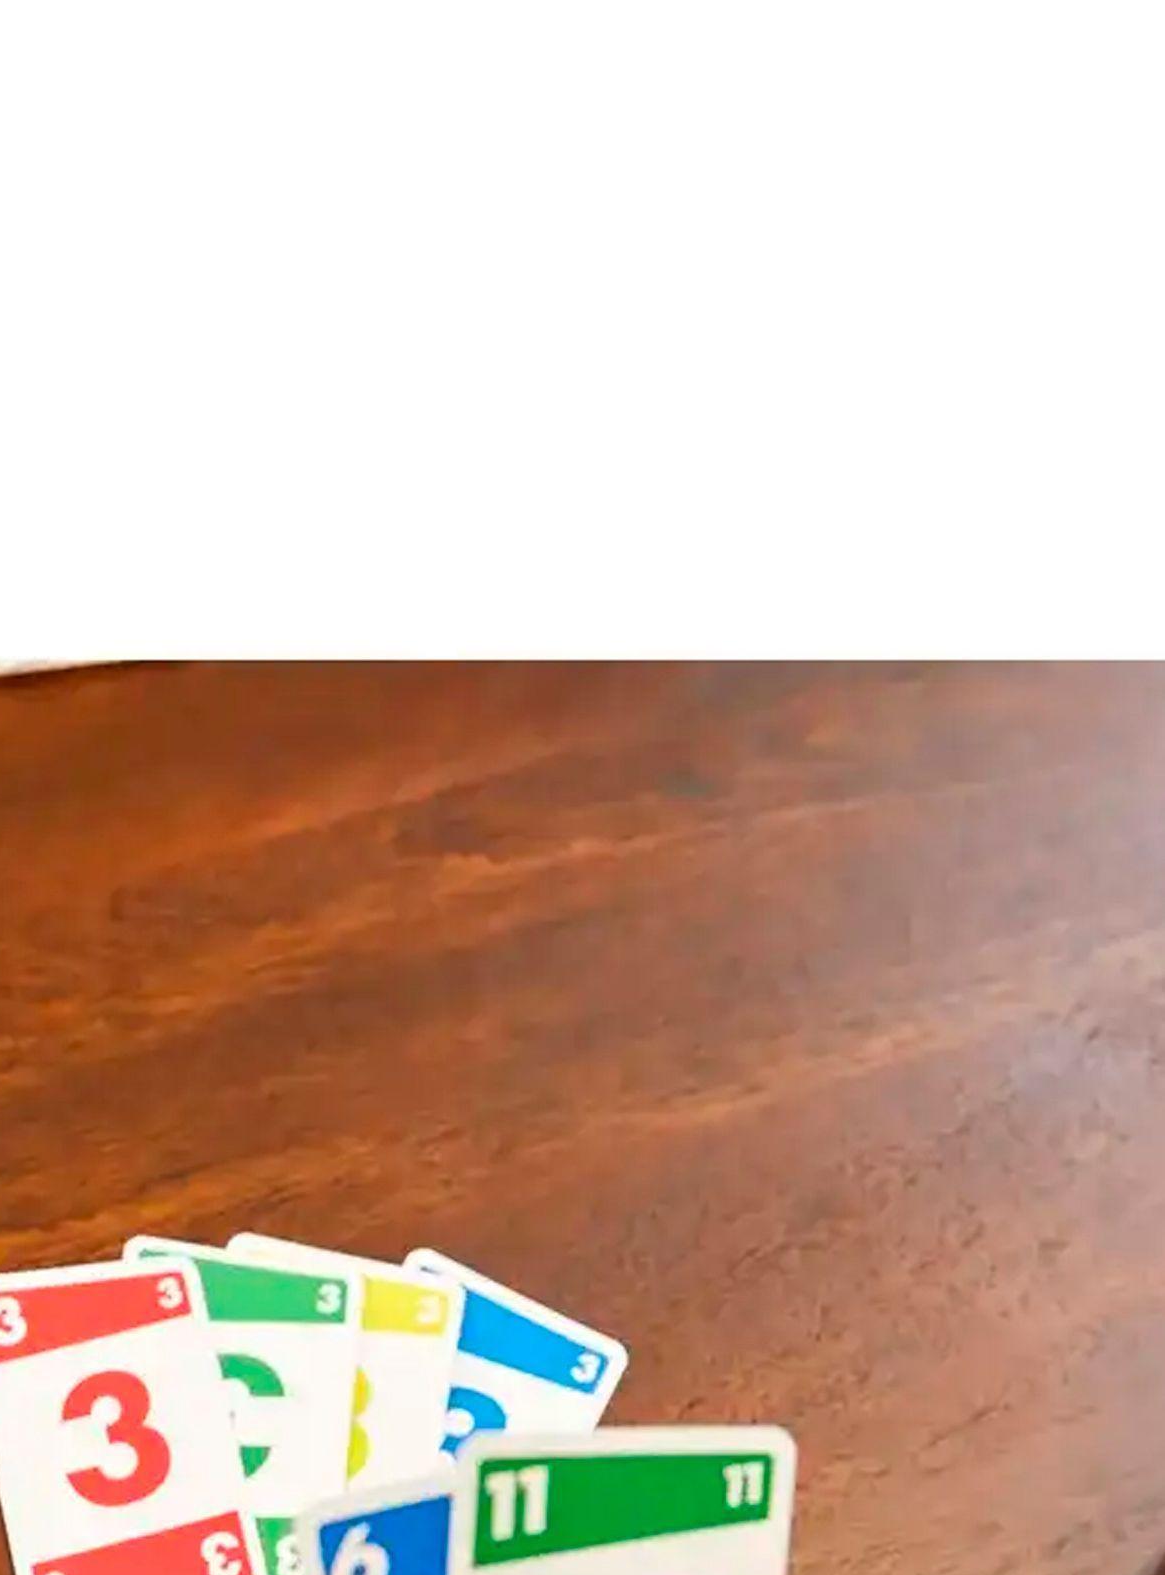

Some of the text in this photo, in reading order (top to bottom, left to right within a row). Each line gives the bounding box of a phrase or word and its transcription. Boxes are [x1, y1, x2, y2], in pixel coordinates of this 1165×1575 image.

[156, 1278, 183, 1308] 3
[316, 1284, 342, 1315] 3
[569, 1353, 601, 1384] 3
[61, 1370, 171, 1507] 3
[485, 1464, 550, 1541] 11
[723, 1462, 765, 1509] 11
